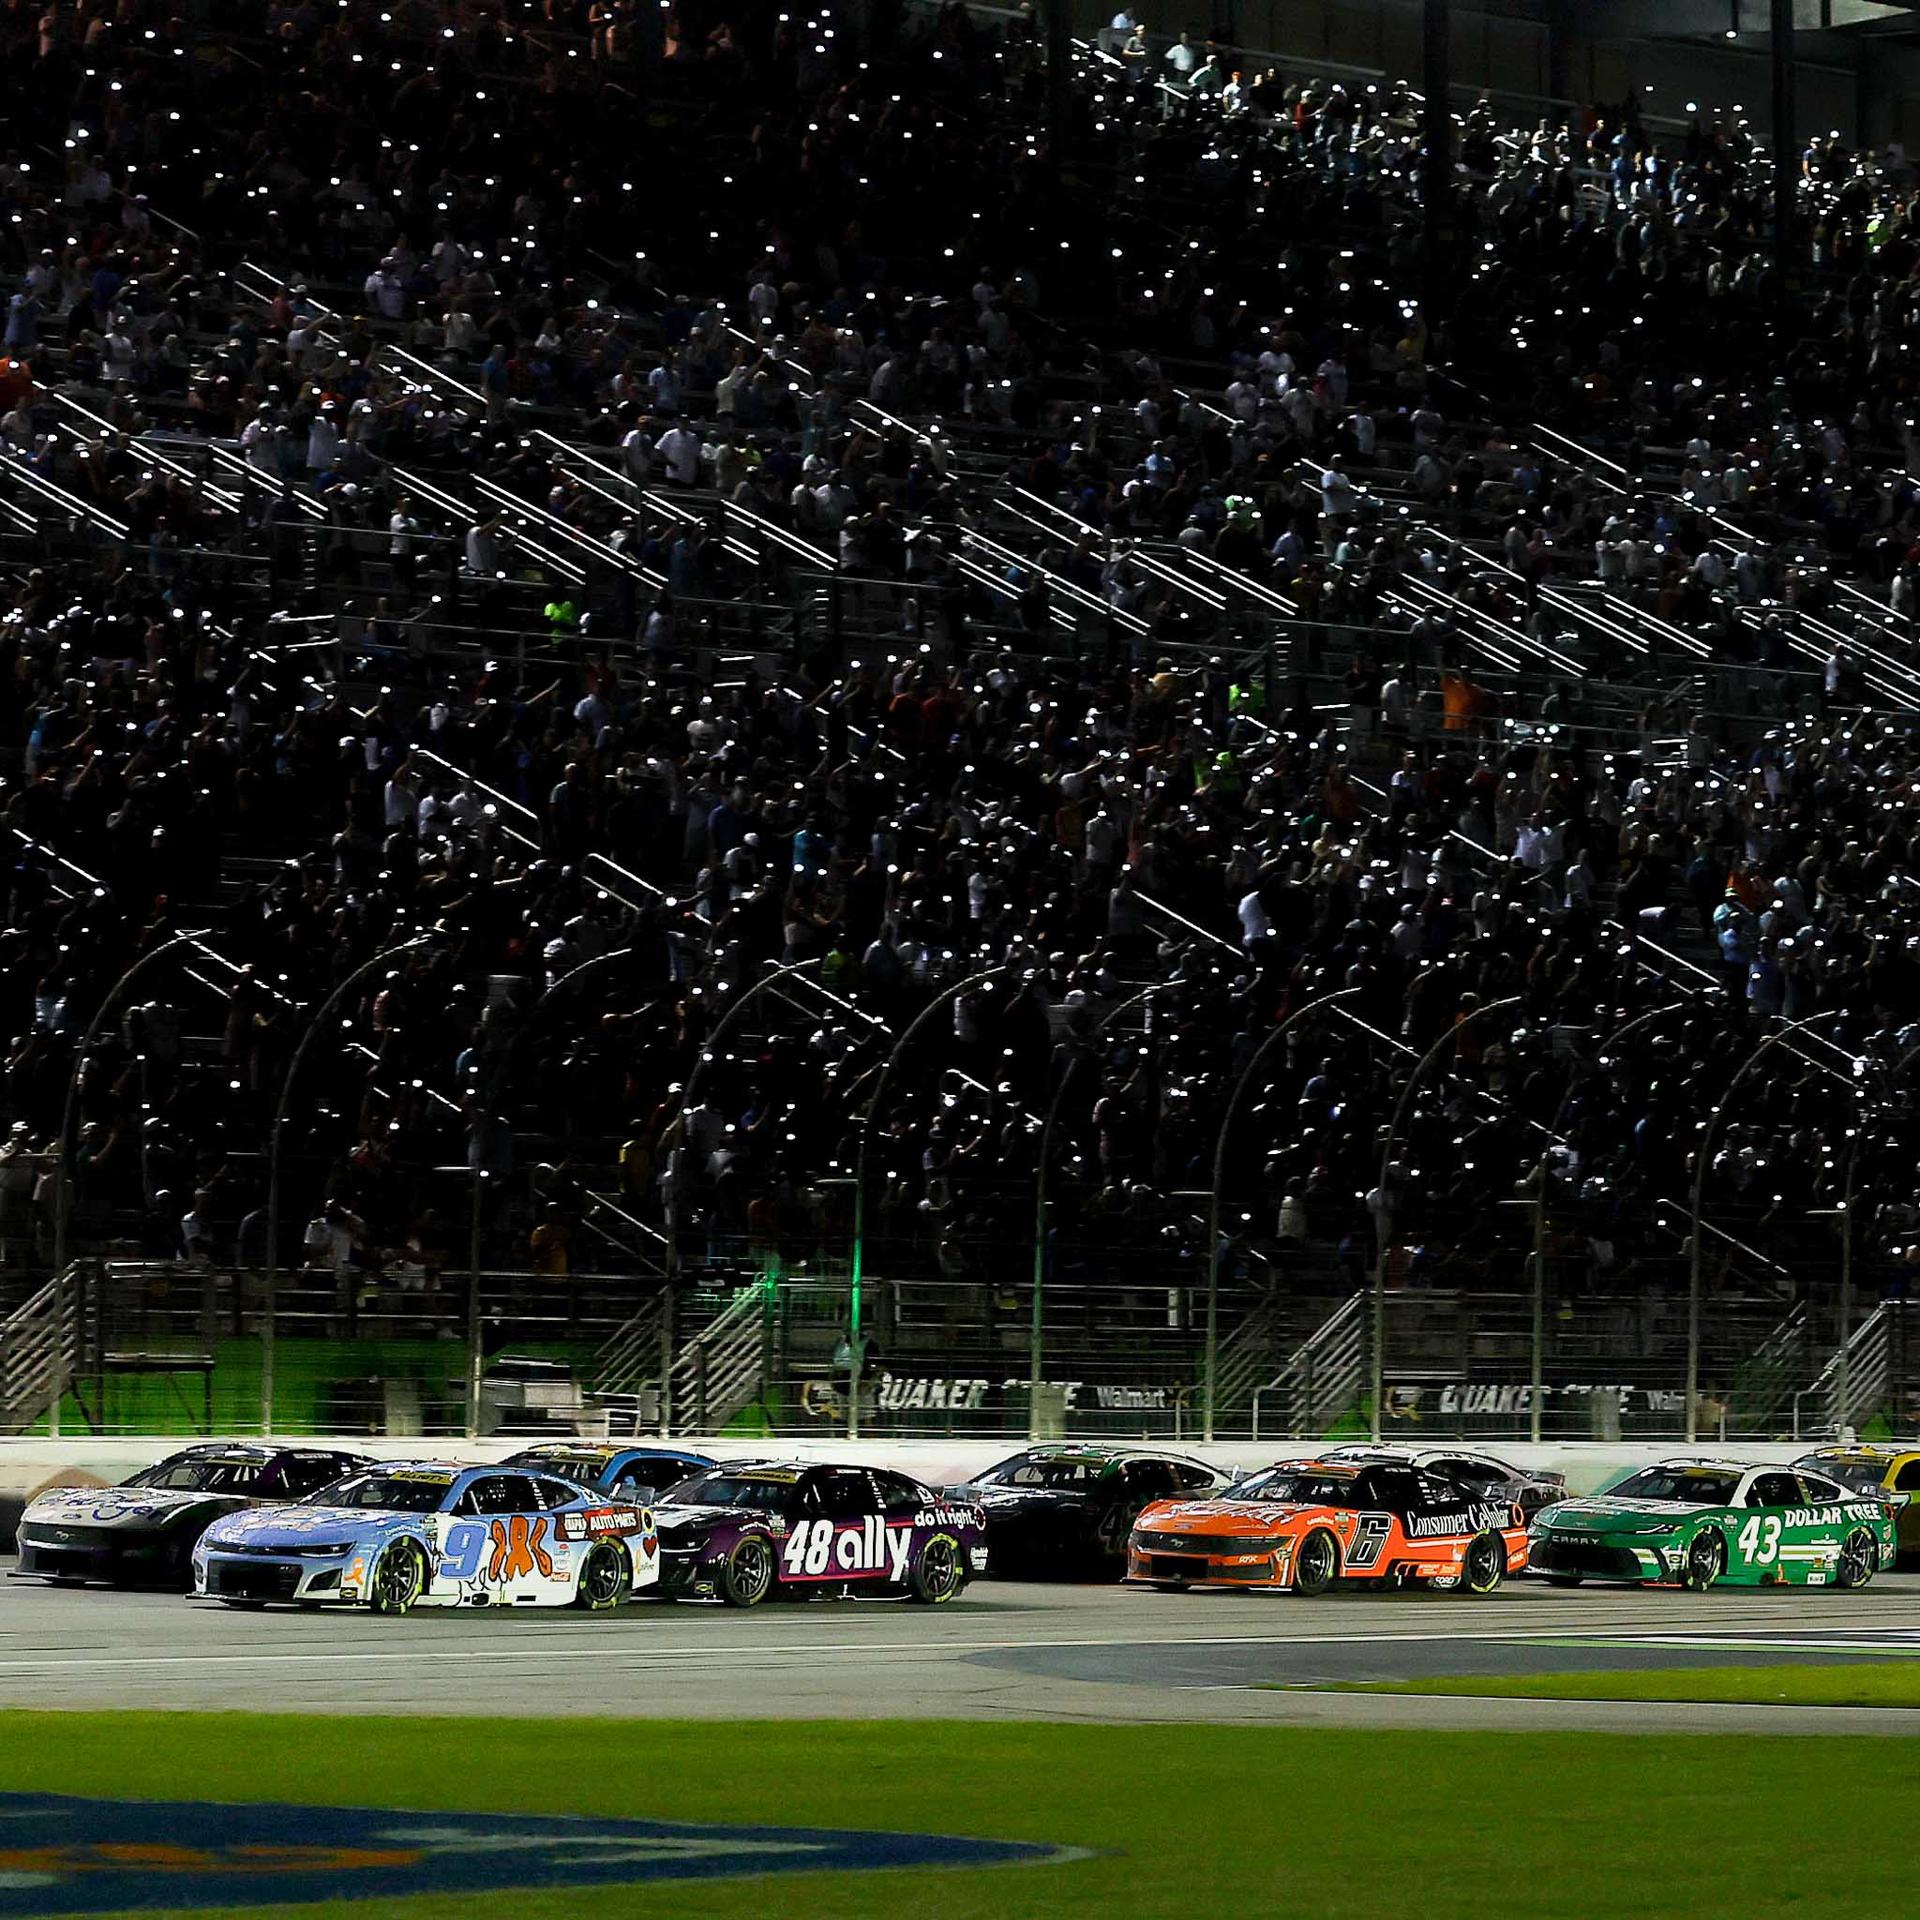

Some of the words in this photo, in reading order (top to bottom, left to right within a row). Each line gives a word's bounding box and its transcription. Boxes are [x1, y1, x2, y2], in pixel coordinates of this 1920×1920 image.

[1440, 1385, 1552, 1413] QUAKE
[590, 1514, 614, 1531] AUTO
[613, 1512, 637, 1529] PARTS
[914, 1510, 935, 1527] do
[935, 1508, 948, 1525] it
[1406, 1510, 1468, 1537] Consumer
[1467, 1502, 1509, 1531] Cellular
[1785, 1506, 1843, 1527] DOLLAR
[1844, 1503, 1883, 1522] TREE
[440, 1522, 487, 1580] 9
[783, 1520, 834, 1575] 48
[837, 1515, 912, 1582] ally
[1345, 1511, 1393, 1569] 6
[1552, 1535, 1600, 1545] CAMRY
[1737, 1516, 1782, 1566] 43
